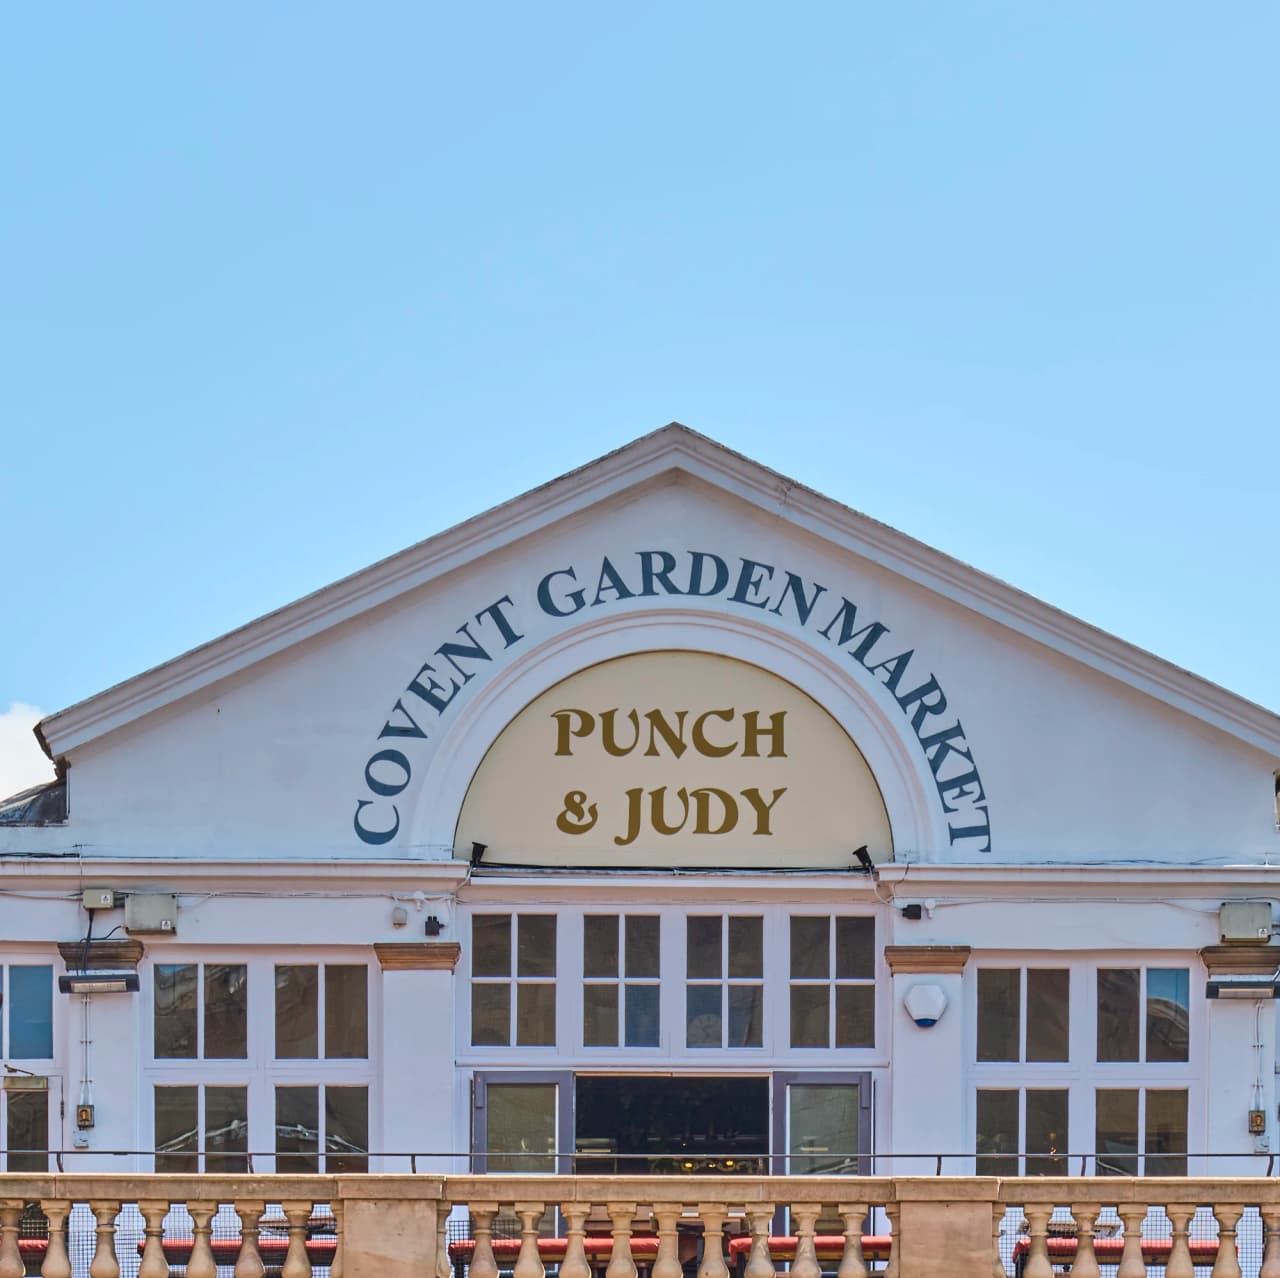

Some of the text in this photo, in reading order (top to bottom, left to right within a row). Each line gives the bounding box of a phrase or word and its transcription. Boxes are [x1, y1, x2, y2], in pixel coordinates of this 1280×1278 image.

[354, 550, 992, 854] COVENT GARDEN MARKET
[550, 707, 789, 759] PUNCH
[556, 786, 789, 847] & JUDY
